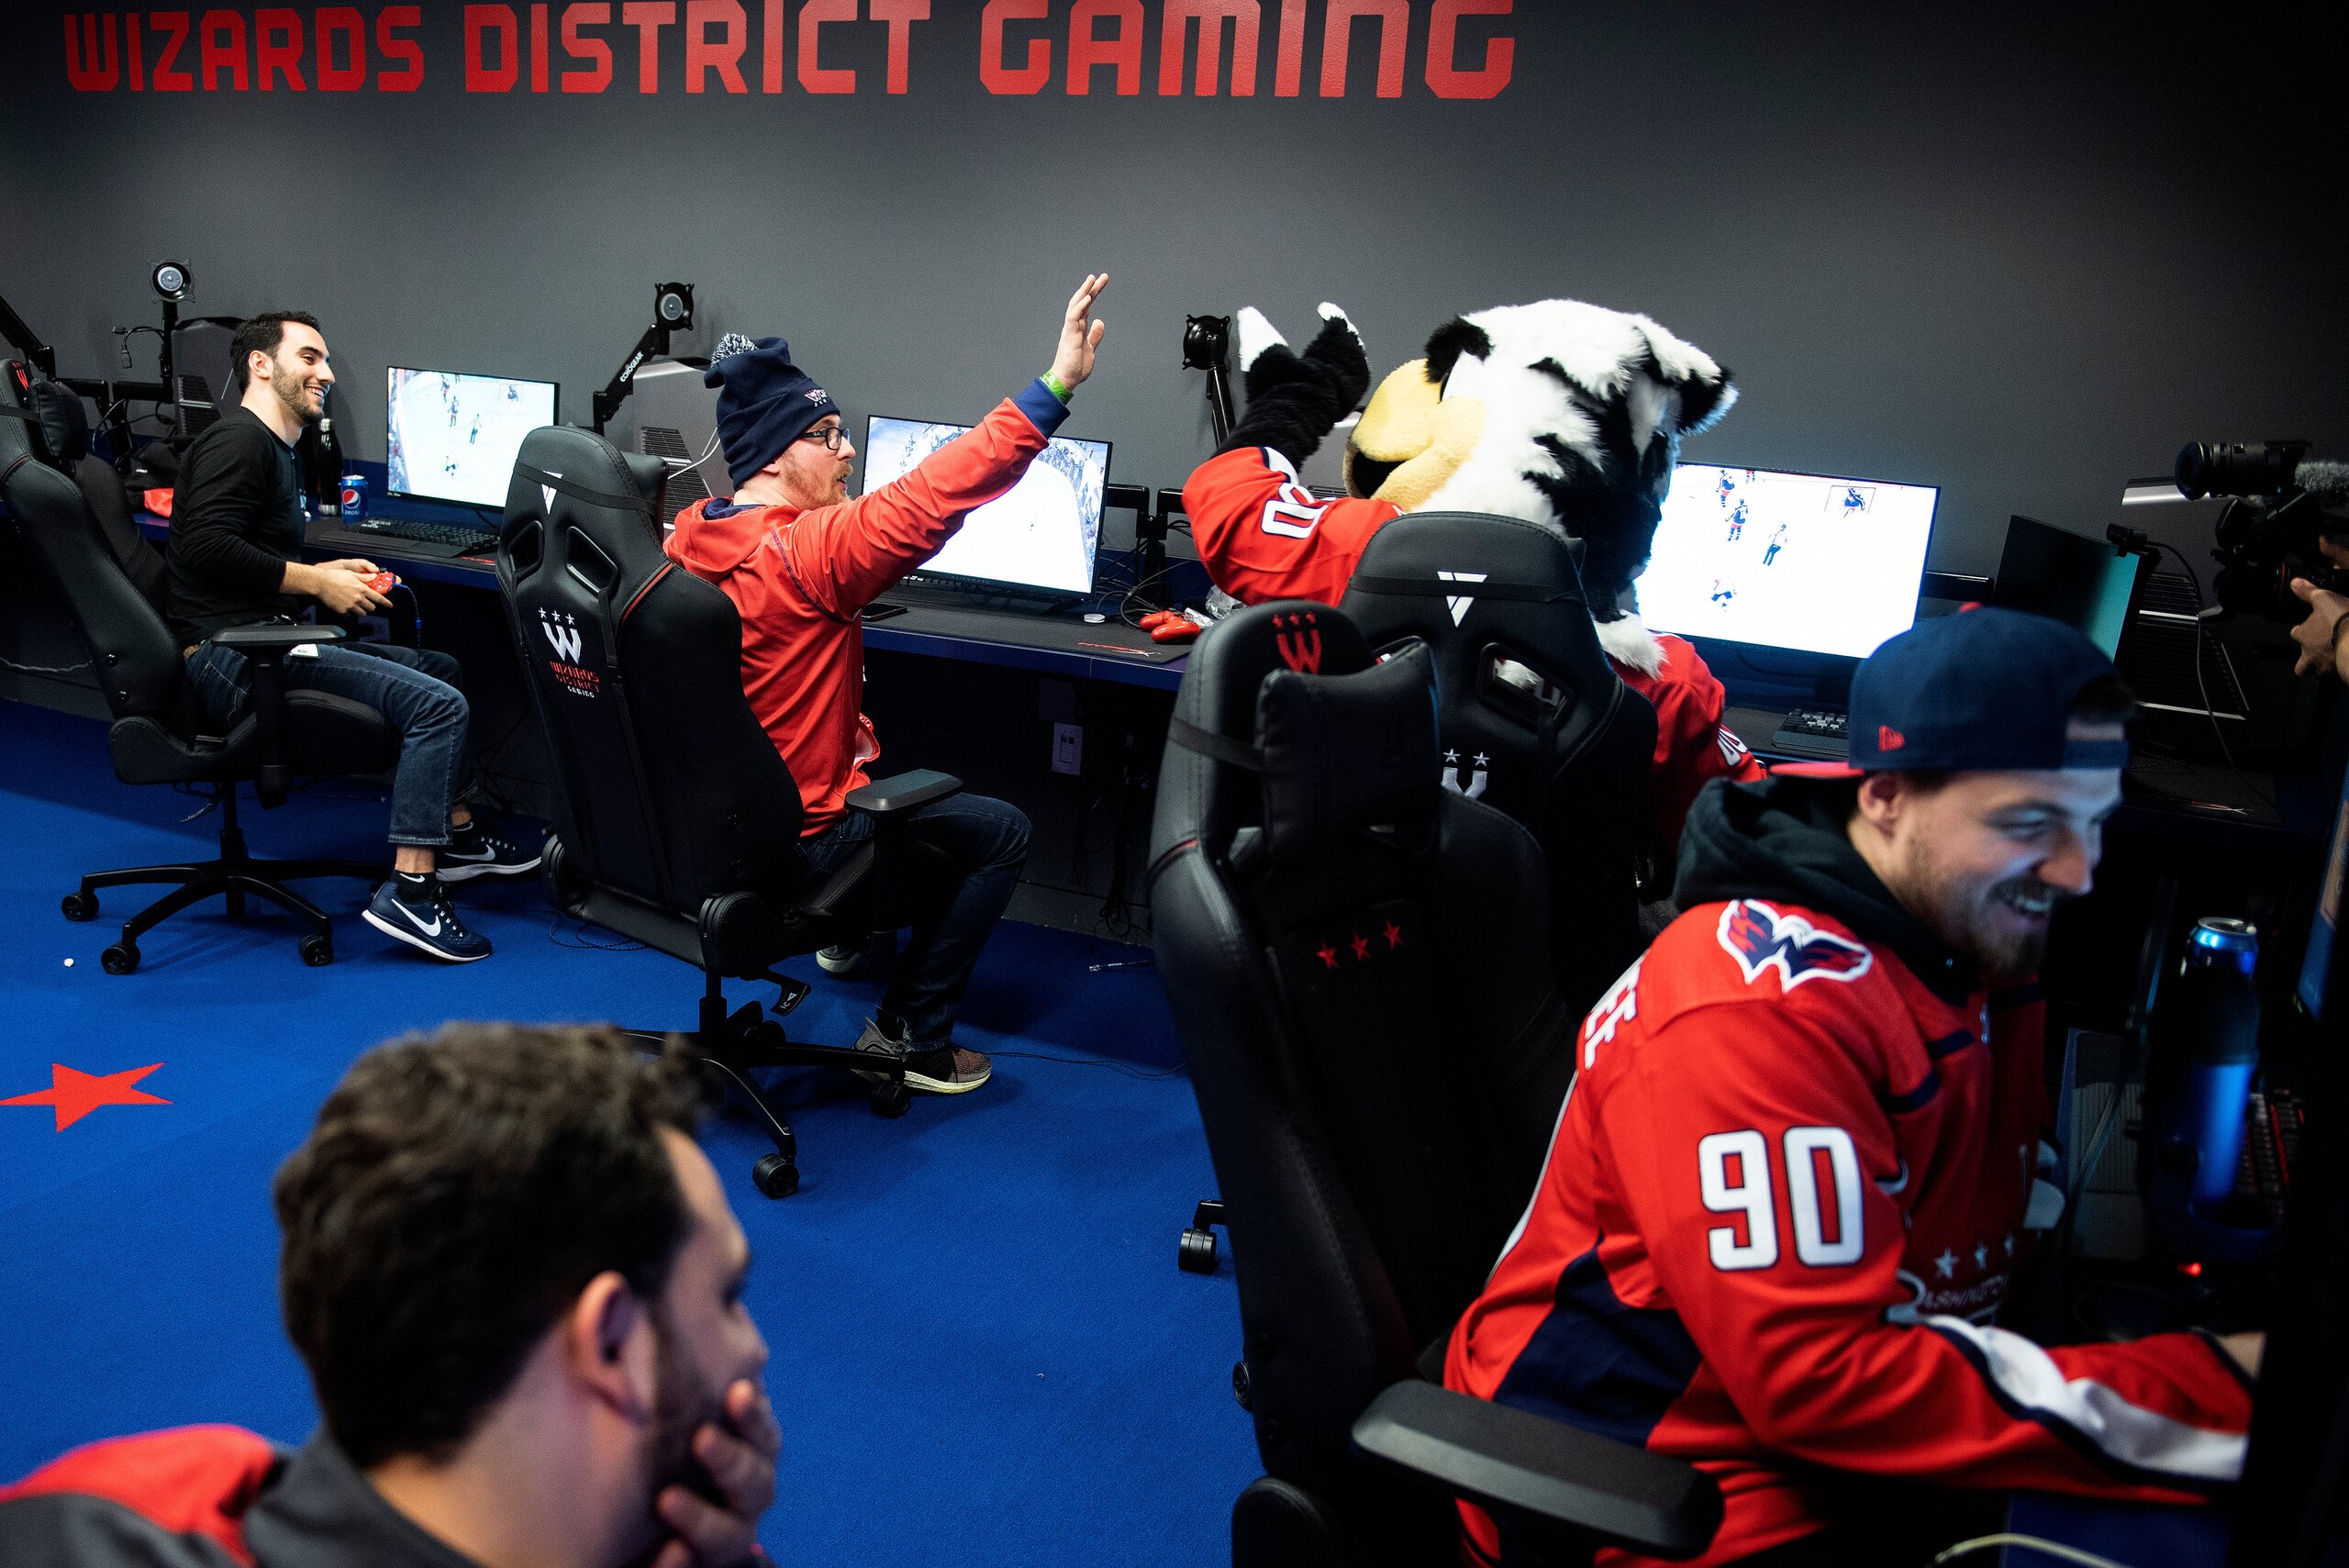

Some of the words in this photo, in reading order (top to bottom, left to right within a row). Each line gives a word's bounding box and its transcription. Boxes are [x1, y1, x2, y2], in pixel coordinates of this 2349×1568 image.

[63, 6, 425, 92] WIZARDS
[463, 0, 931, 94] DISTRICT
[979, 0, 1515, 98] GAMING
[550, 661, 599, 683] WIZARDS
[1698, 1125, 1865, 1272] 90
